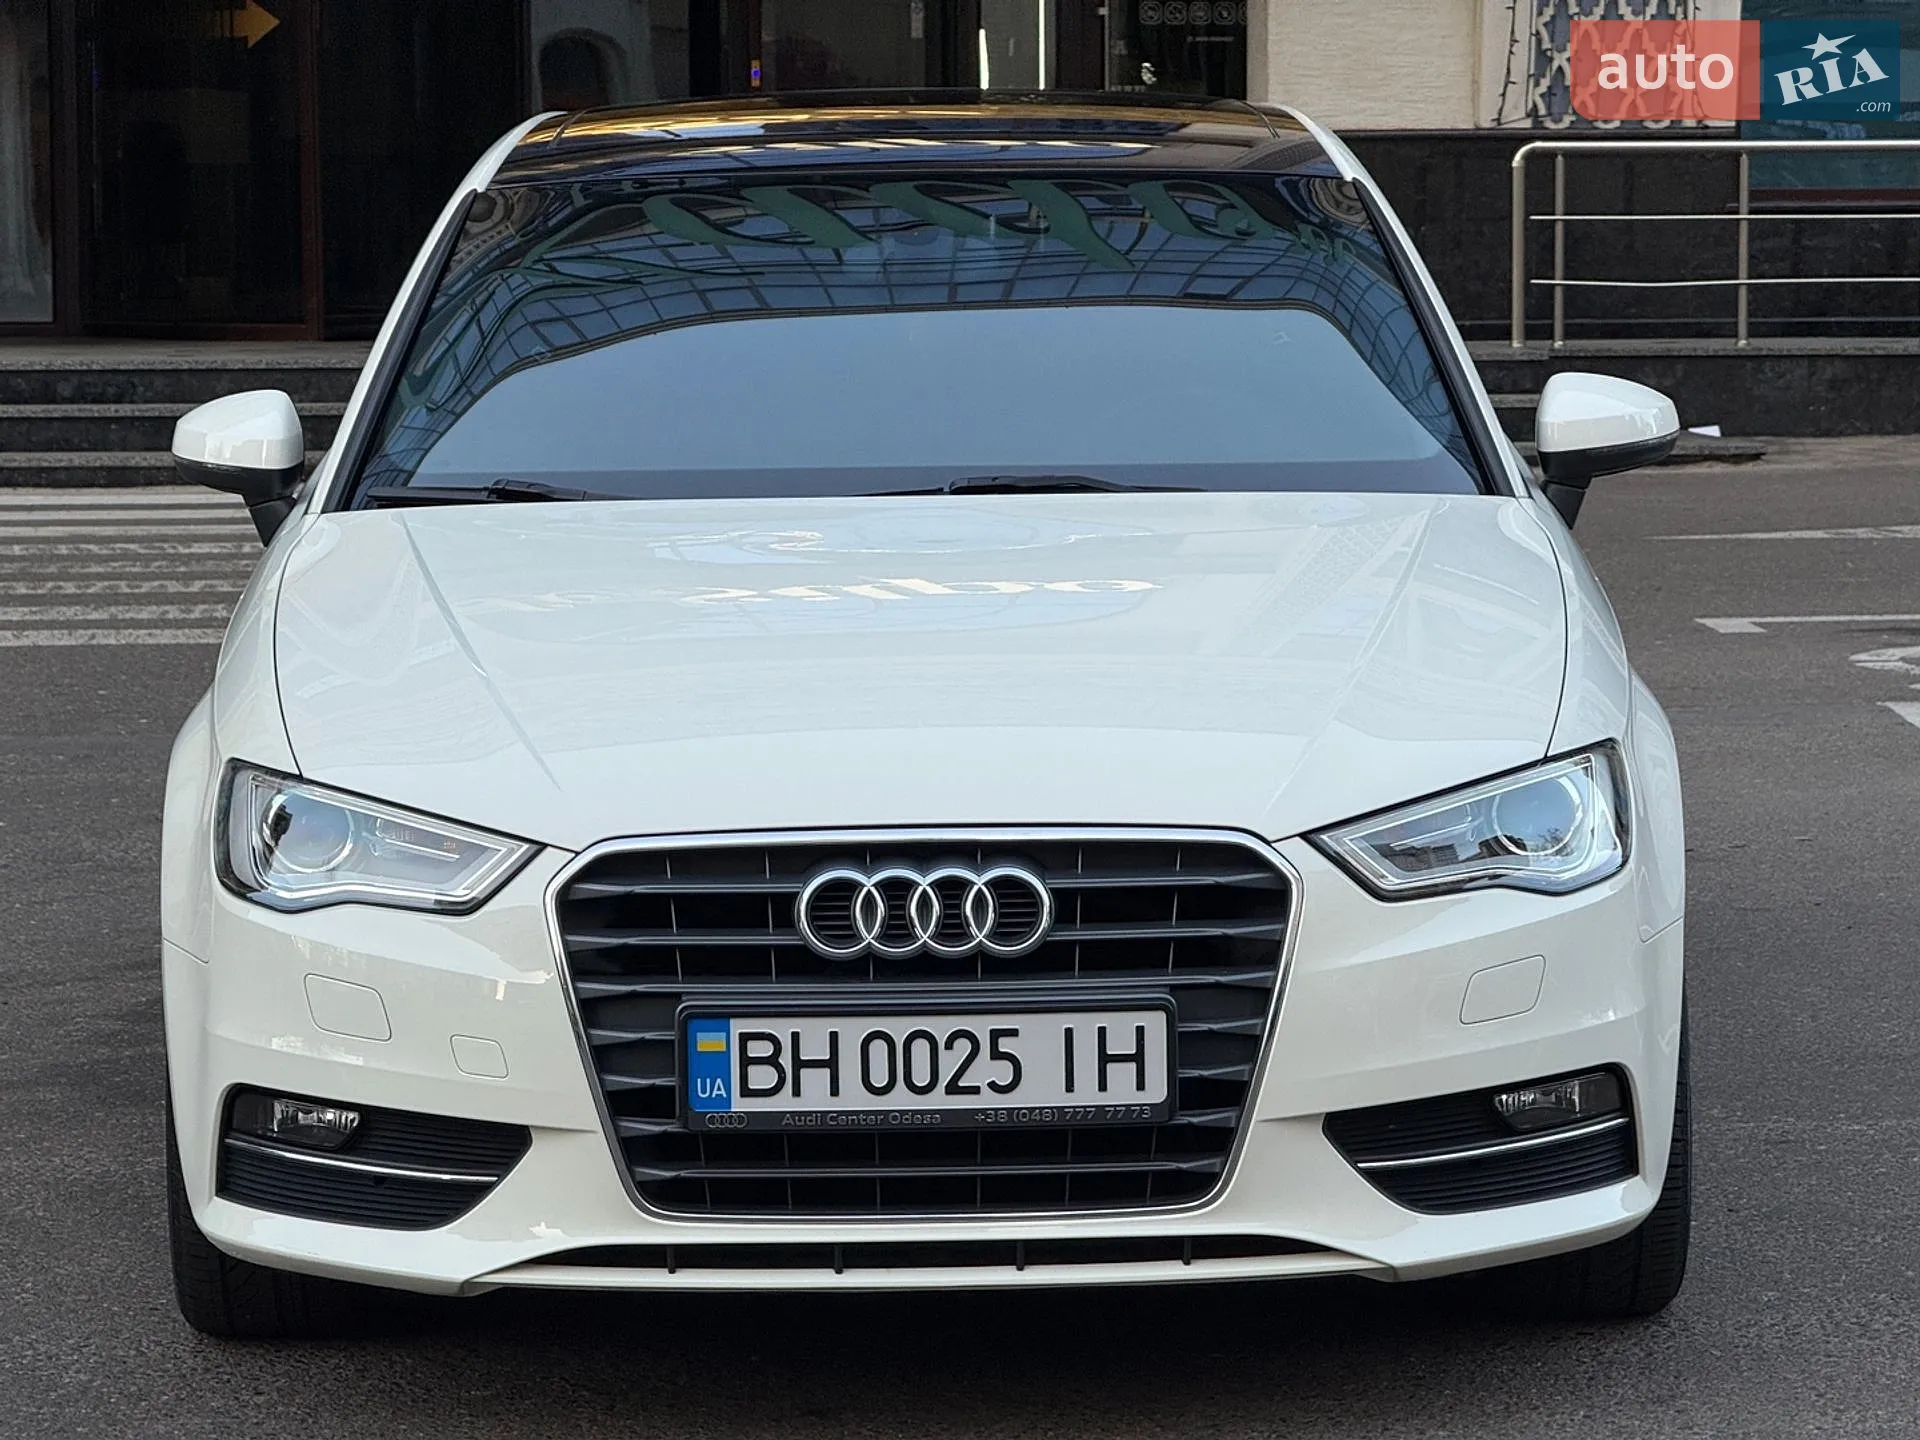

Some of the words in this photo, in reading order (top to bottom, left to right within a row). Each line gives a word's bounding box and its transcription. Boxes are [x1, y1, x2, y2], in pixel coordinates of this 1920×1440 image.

[738, 1030, 841, 1099] BH
[859, 1027, 1023, 1098] 0025
[1064, 1024, 1146, 1094] IH
[697, 1077, 727, 1099] UA
[782, 1113, 822, 1126] Audi
[826, 1113, 884, 1126] Center
[888, 1112, 942, 1125] Odesa
[974, 1110, 1008, 1123] +38
[1013, 1109, 1059, 1122] (048)
[1064, 1107, 1096, 1120] 777
[1104, 1107, 1126, 1119] 77
[1130, 1106, 1152, 1119] 73
